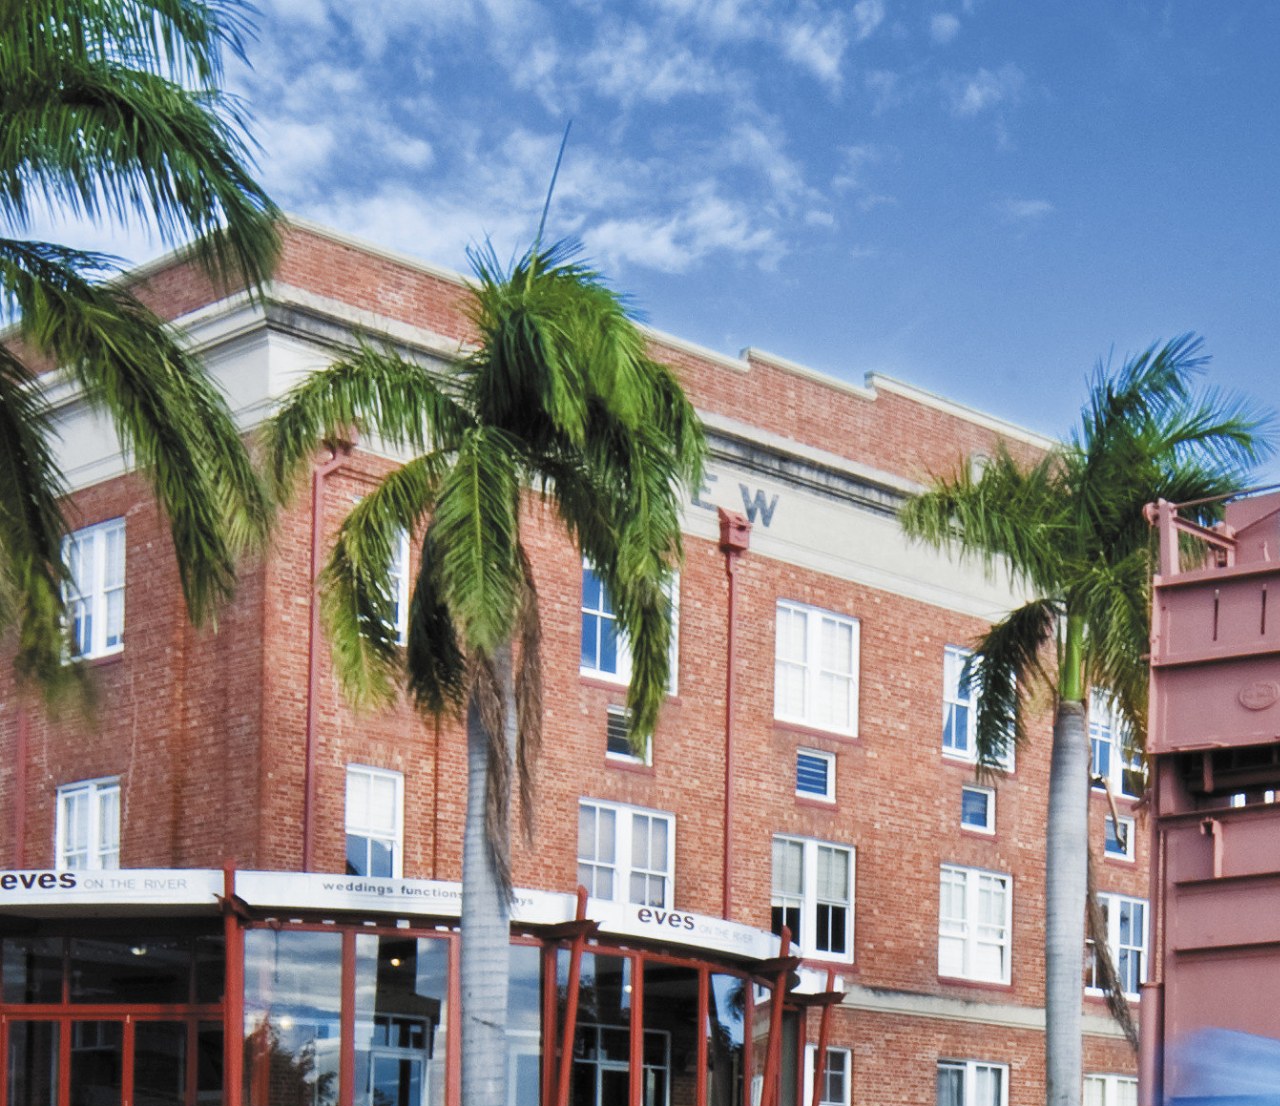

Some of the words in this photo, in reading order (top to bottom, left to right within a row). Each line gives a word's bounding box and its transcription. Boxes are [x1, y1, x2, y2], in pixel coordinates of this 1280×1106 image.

[0, 872, 77, 890] eves
[83, 878, 104, 889] ON
[109, 878, 136, 889] THE
[143, 878, 188, 889] RIVER
[323, 881, 394, 895] weddings
[637, 907, 695, 931] eves
